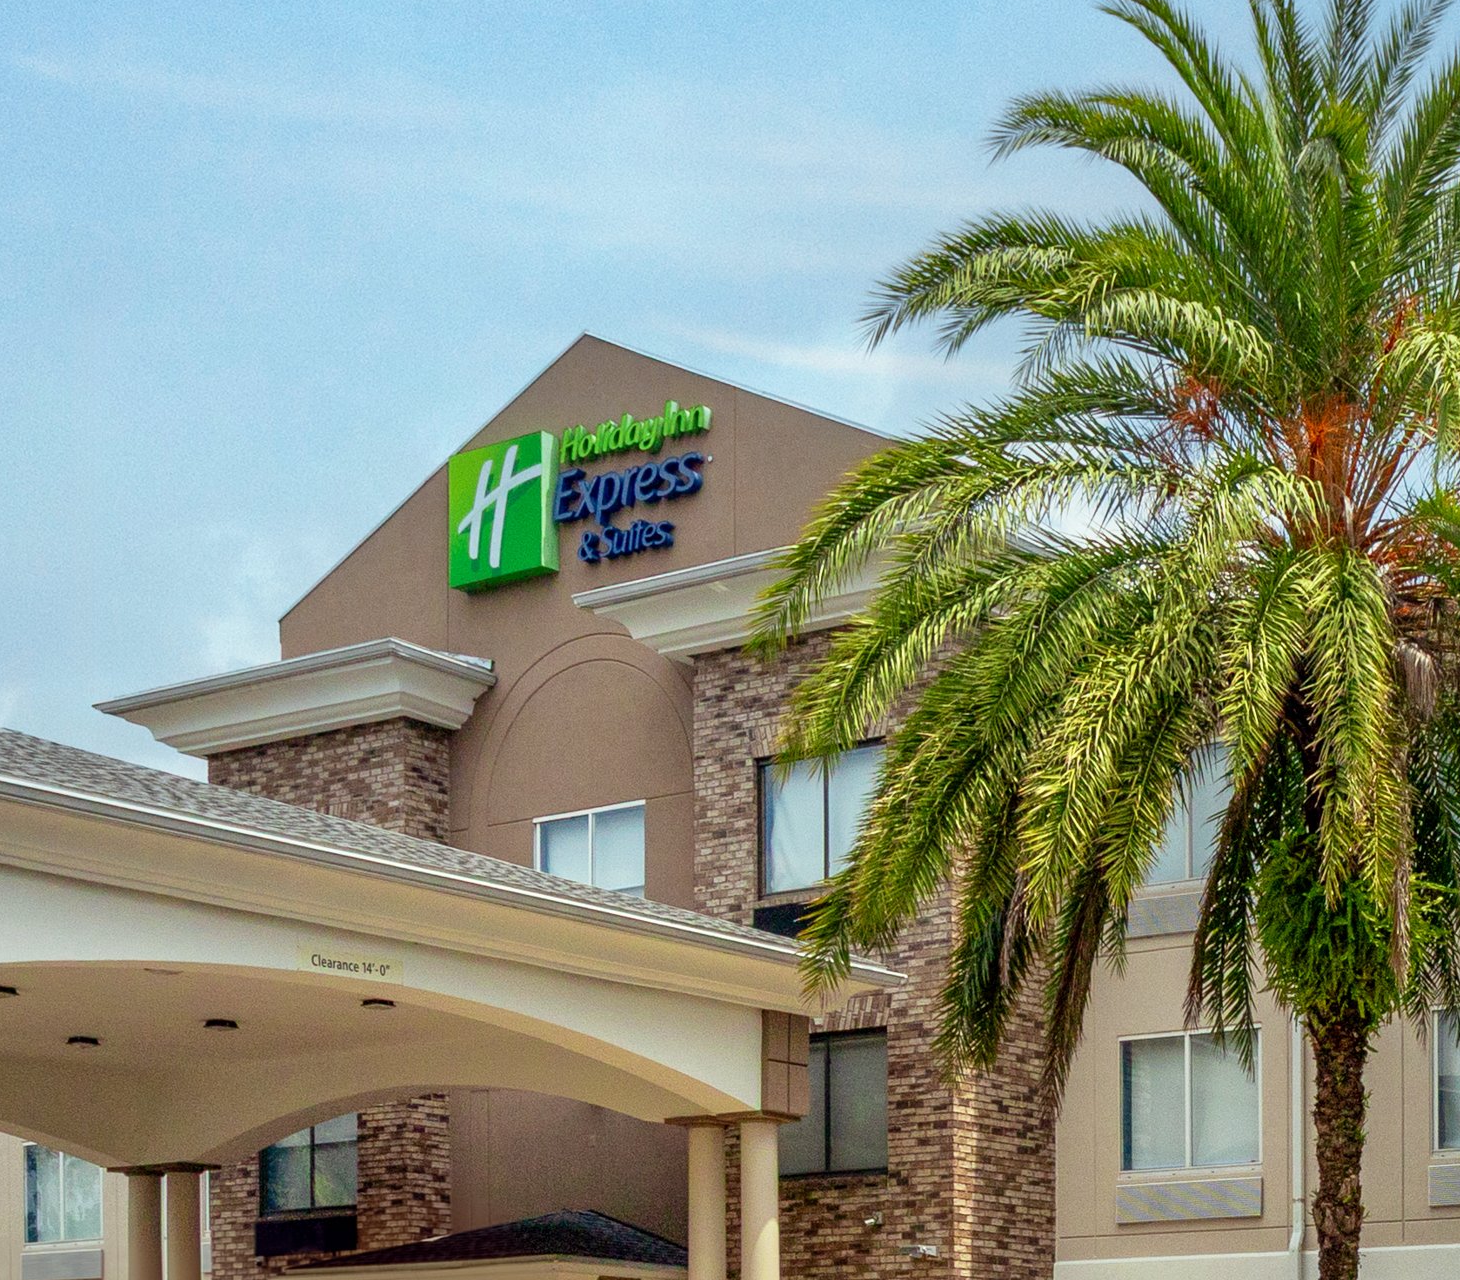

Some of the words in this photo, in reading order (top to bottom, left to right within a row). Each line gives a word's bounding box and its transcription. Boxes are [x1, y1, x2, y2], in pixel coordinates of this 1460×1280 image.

[560, 412, 666, 464] Holiday
[663, 400, 712, 438] Inn
[553, 451, 705, 528] Express
[577, 530, 601, 564] &
[600, 519, 676, 559] Suites
[311, 953, 360, 973] Clearance
